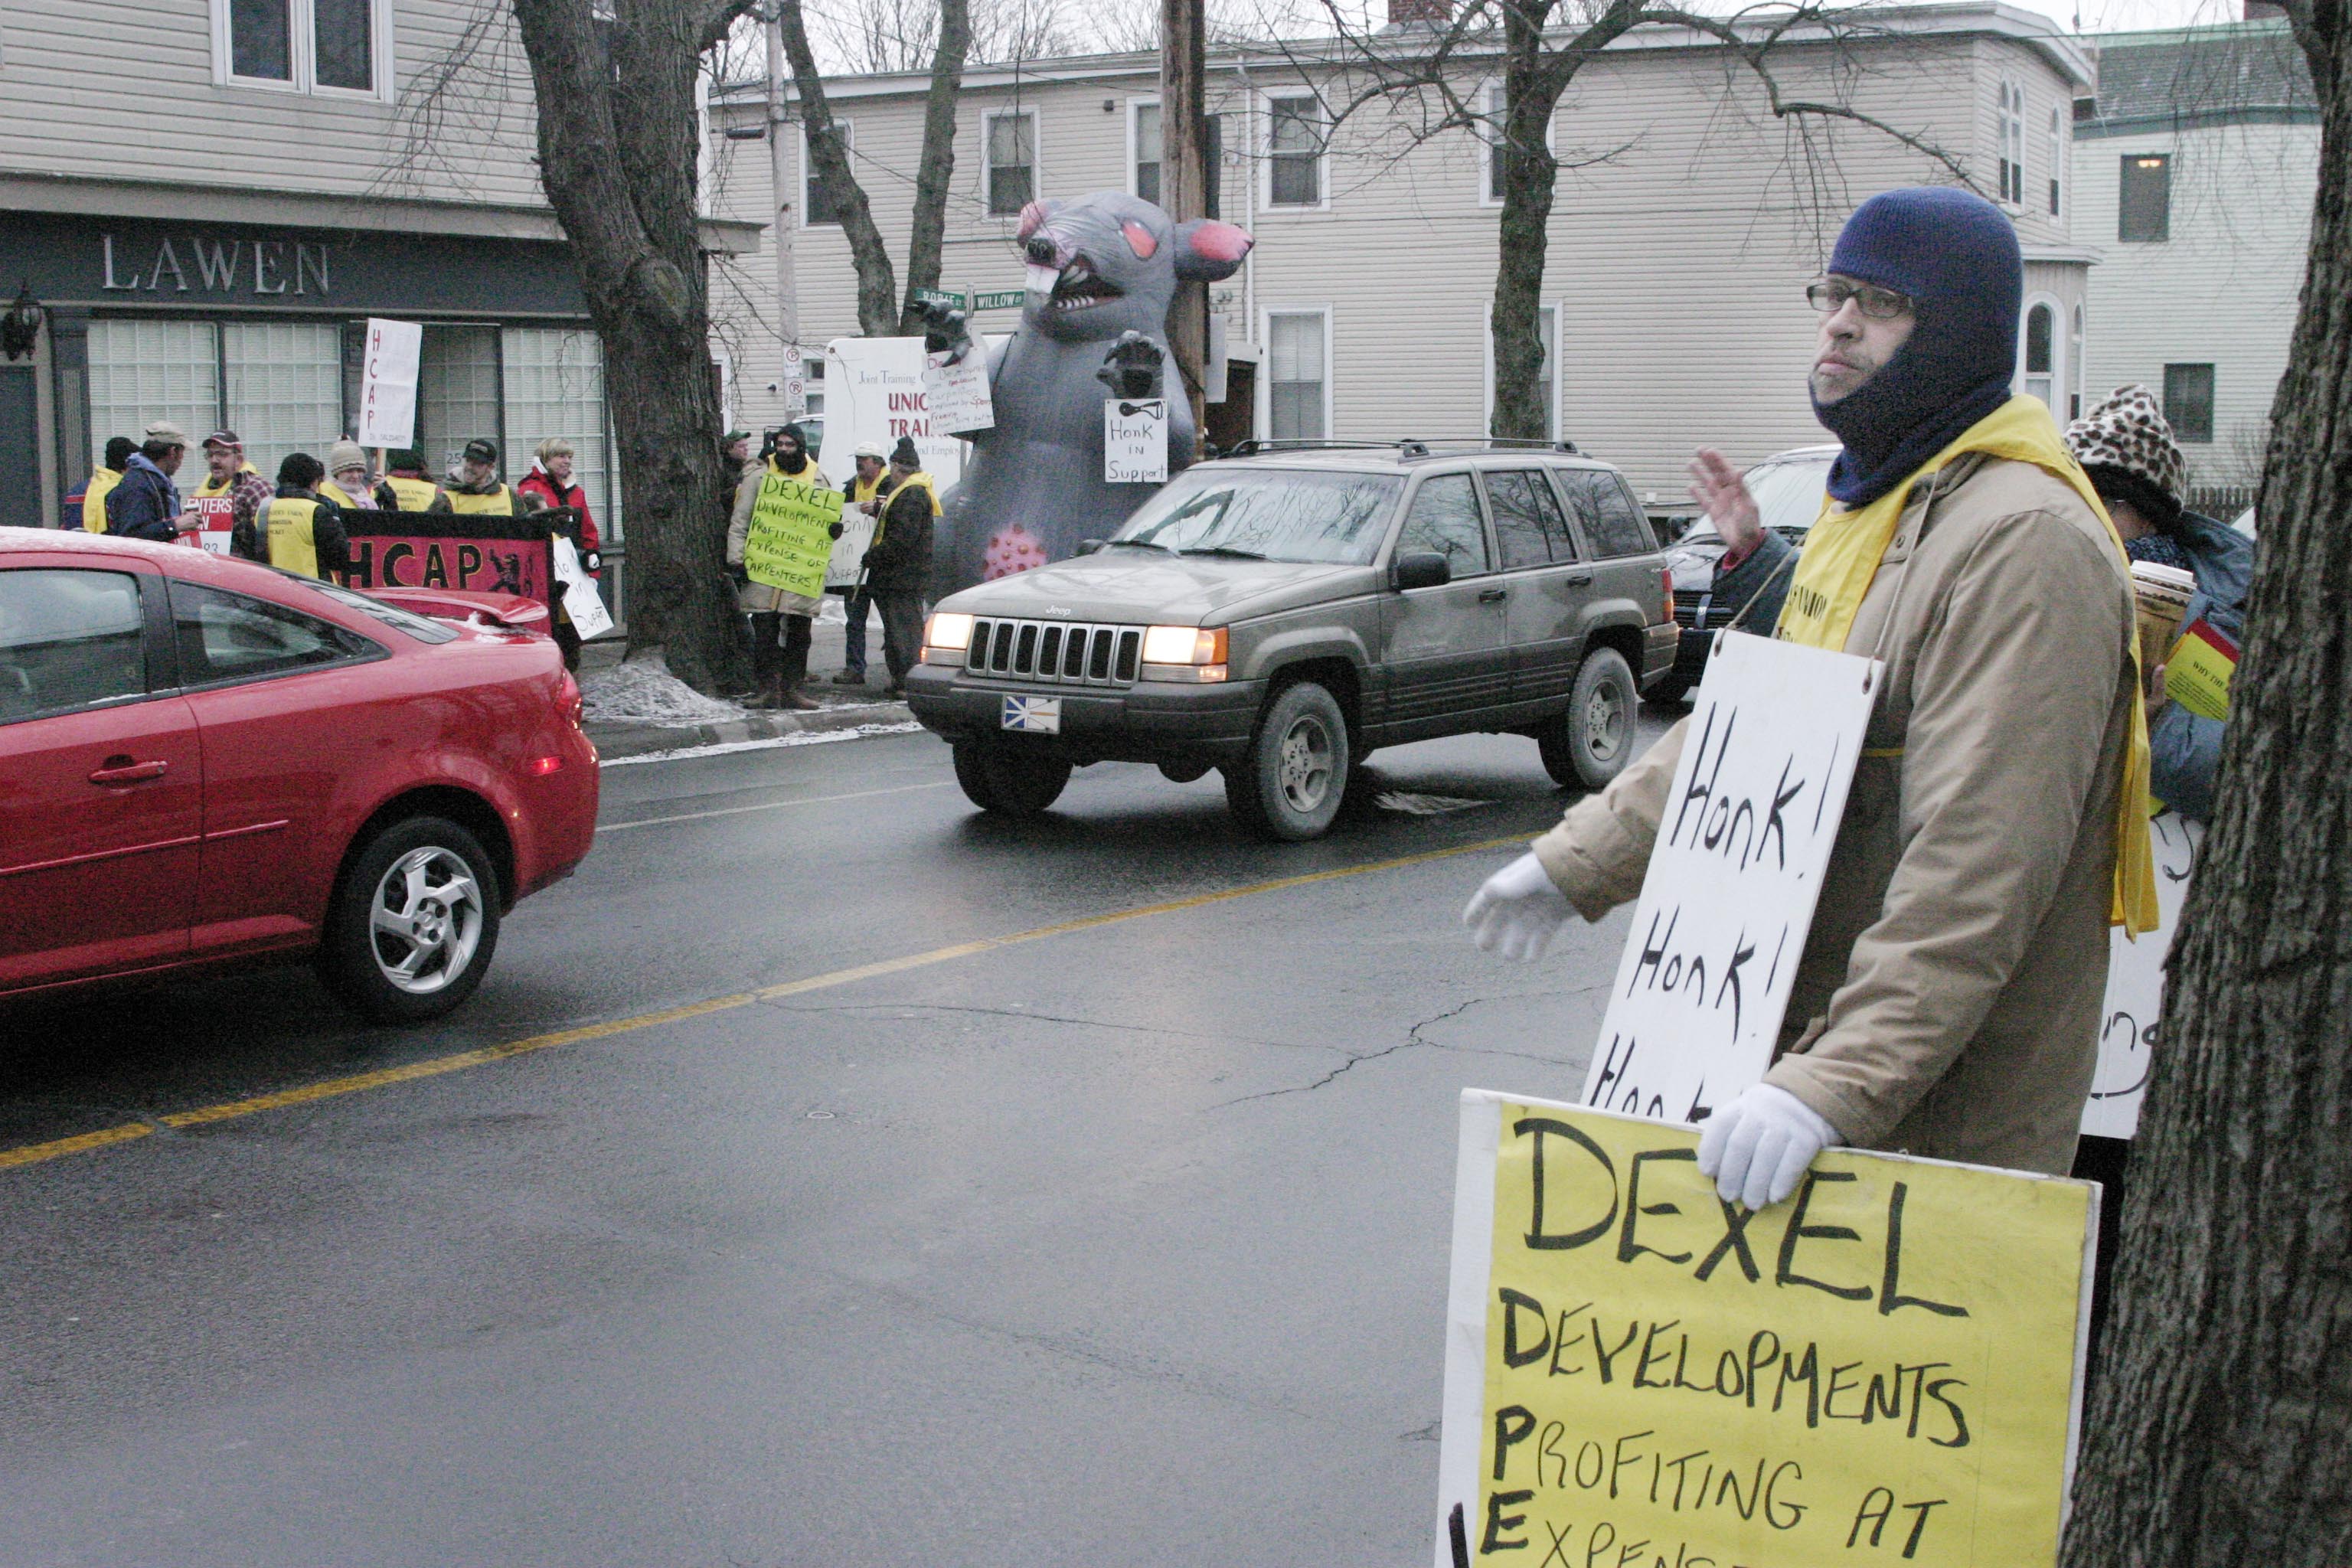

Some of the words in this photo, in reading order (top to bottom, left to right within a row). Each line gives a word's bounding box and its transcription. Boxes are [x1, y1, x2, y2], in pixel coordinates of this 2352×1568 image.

[102, 234, 329, 295] LAWEN
[977, 293, 1014, 309] WILLOW
[858, 370, 878, 384] Joint
[880, 370, 916, 385] Training
[1110, 419, 1154, 441] Honk
[1108, 460, 1165, 482] Support
[764, 473, 838, 511] DEXEL
[752, 516, 806, 545] PROFITING
[815, 538, 833, 551] AT
[339, 541, 483, 589] HCAP
[746, 537, 798, 563] EXPENSE
[807, 560, 825, 568] OF
[1045, 605, 1072, 616] Jeep
[2193, 660, 2210, 677] WHY
[1513, 1118, 1970, 1318] DEXEL
[1498, 1287, 1971, 1448] DEVELOPMENTS
[1494, 1404, 1808, 1530] PROFITING
[1846, 1488, 1948, 1560] AT
